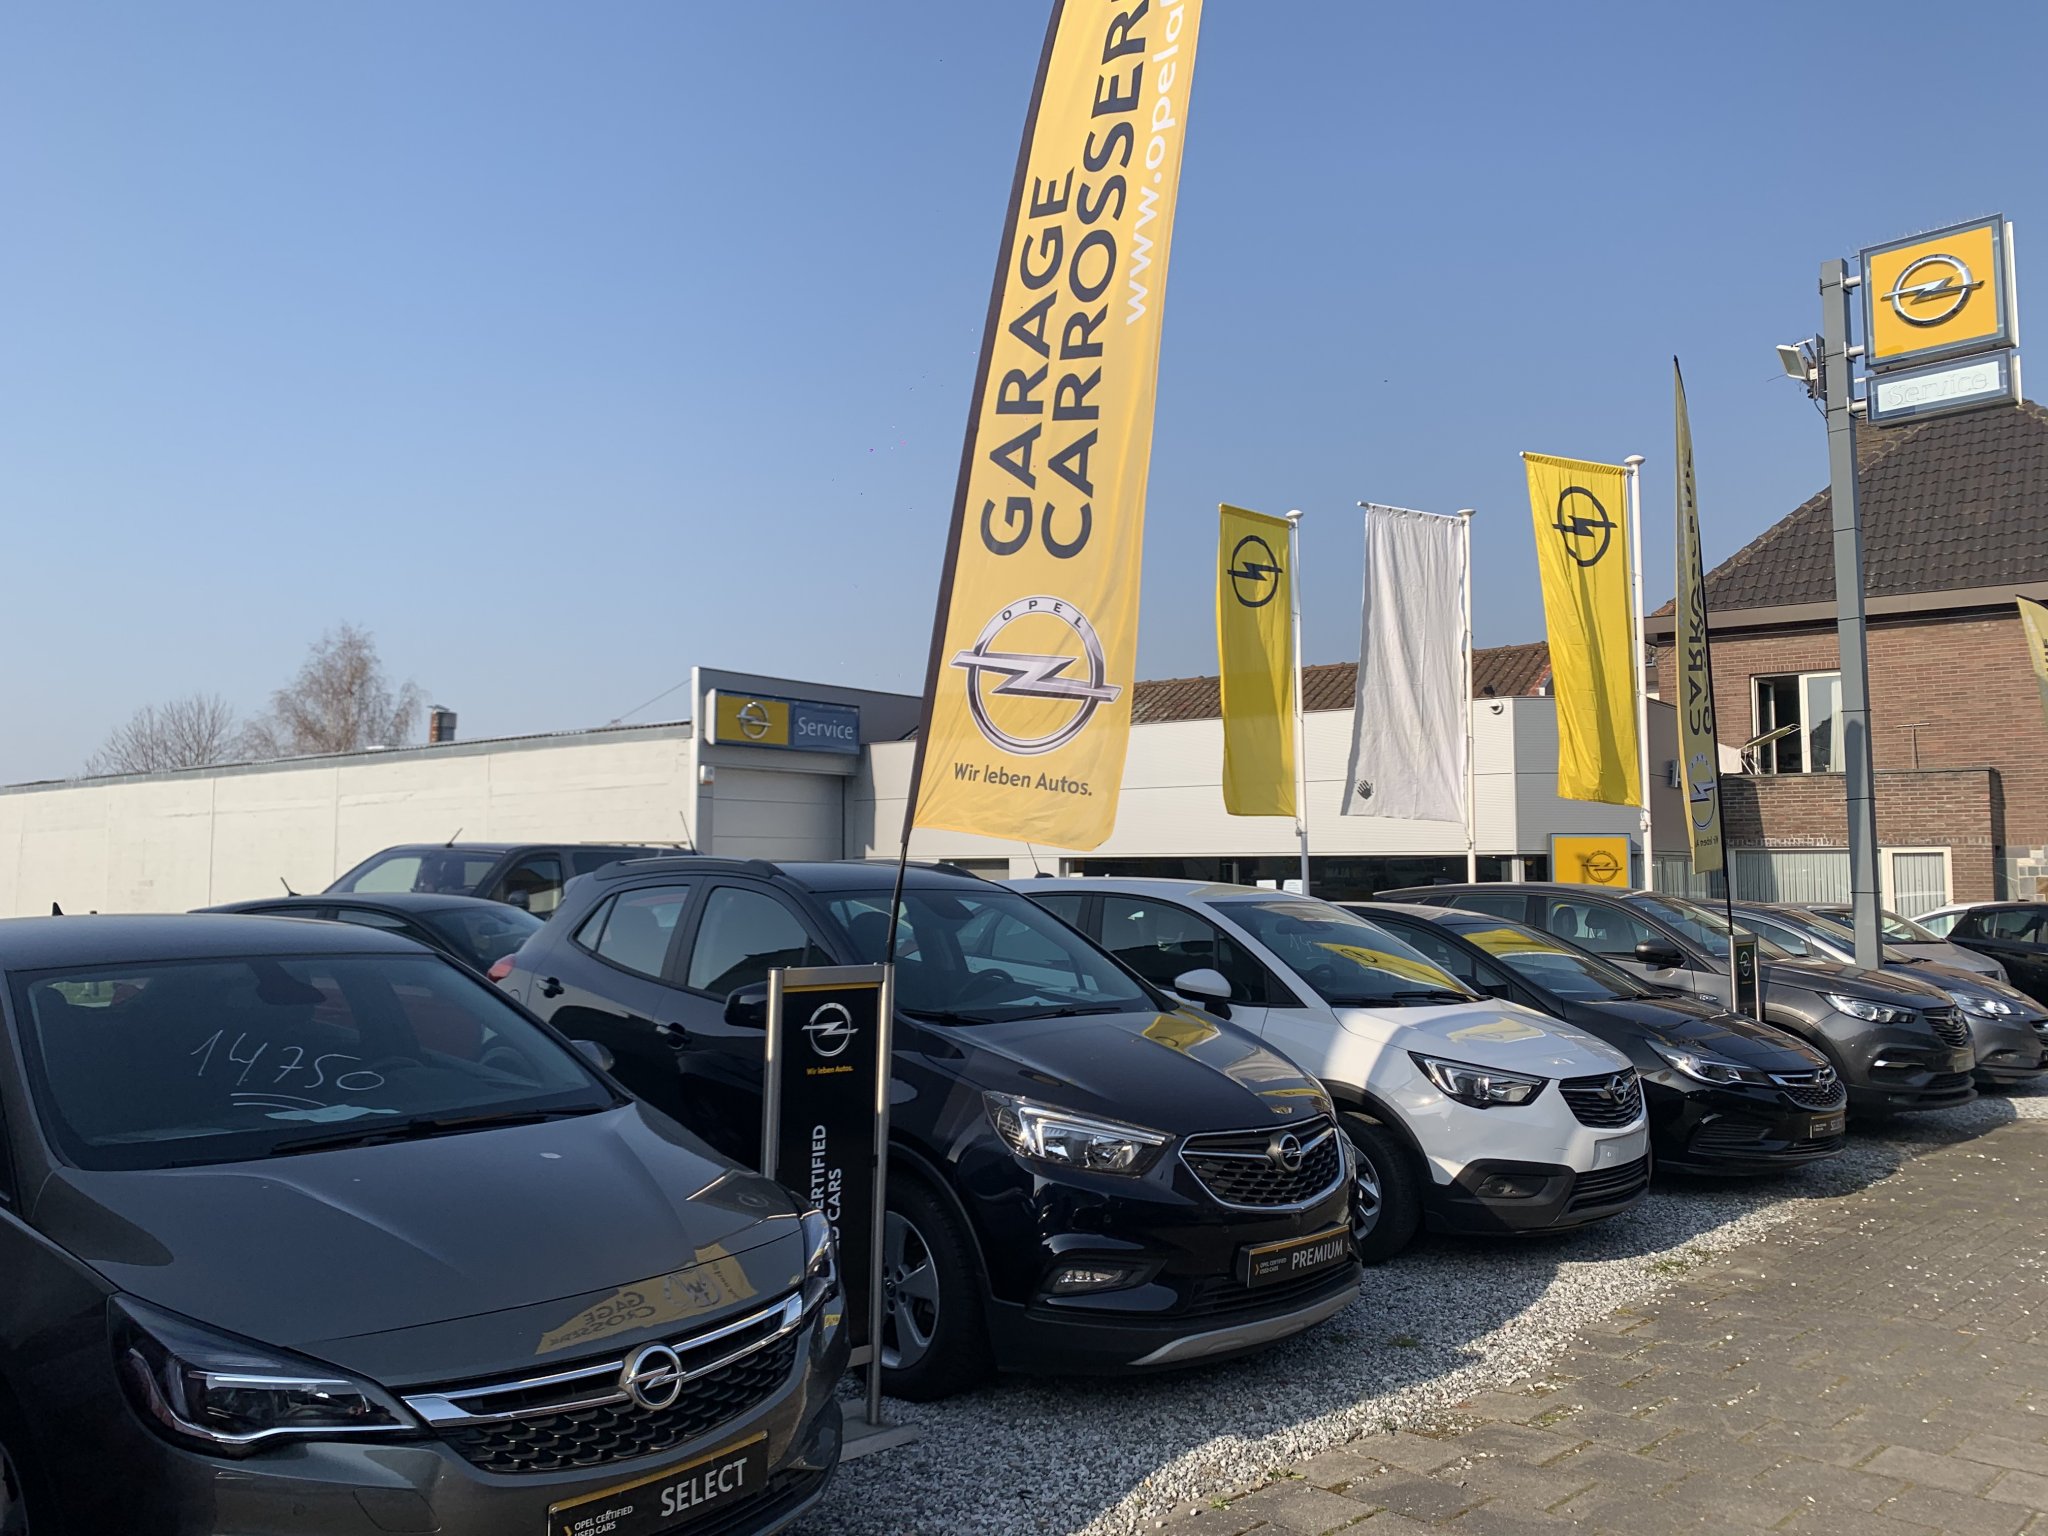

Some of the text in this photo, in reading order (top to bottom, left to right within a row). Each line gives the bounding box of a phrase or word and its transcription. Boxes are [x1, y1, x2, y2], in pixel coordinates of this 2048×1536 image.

[1126, 0, 1185, 325] www.opela
[1041, 0, 1150, 559] CARROSSER
[980, 166, 1075, 556] GARAGE
[1887, 370, 1988, 406] Service
[1002, 599, 1086, 630] OPEL
[798, 716, 853, 740] Service
[954, 762, 1092, 796] Wir leben Autos.
[190, 1029, 384, 1091] 14750
[811, 1124, 826, 1211] ERTIFIED
[827, 1168, 842, 1222] CARS
[1291, 1239, 1343, 1270] PREMIUM
[660, 1457, 748, 1518] SELECT
[574, 1505, 634, 1531] OPEL CERTIFIED
[595, 1521, 616, 1534] CARS
